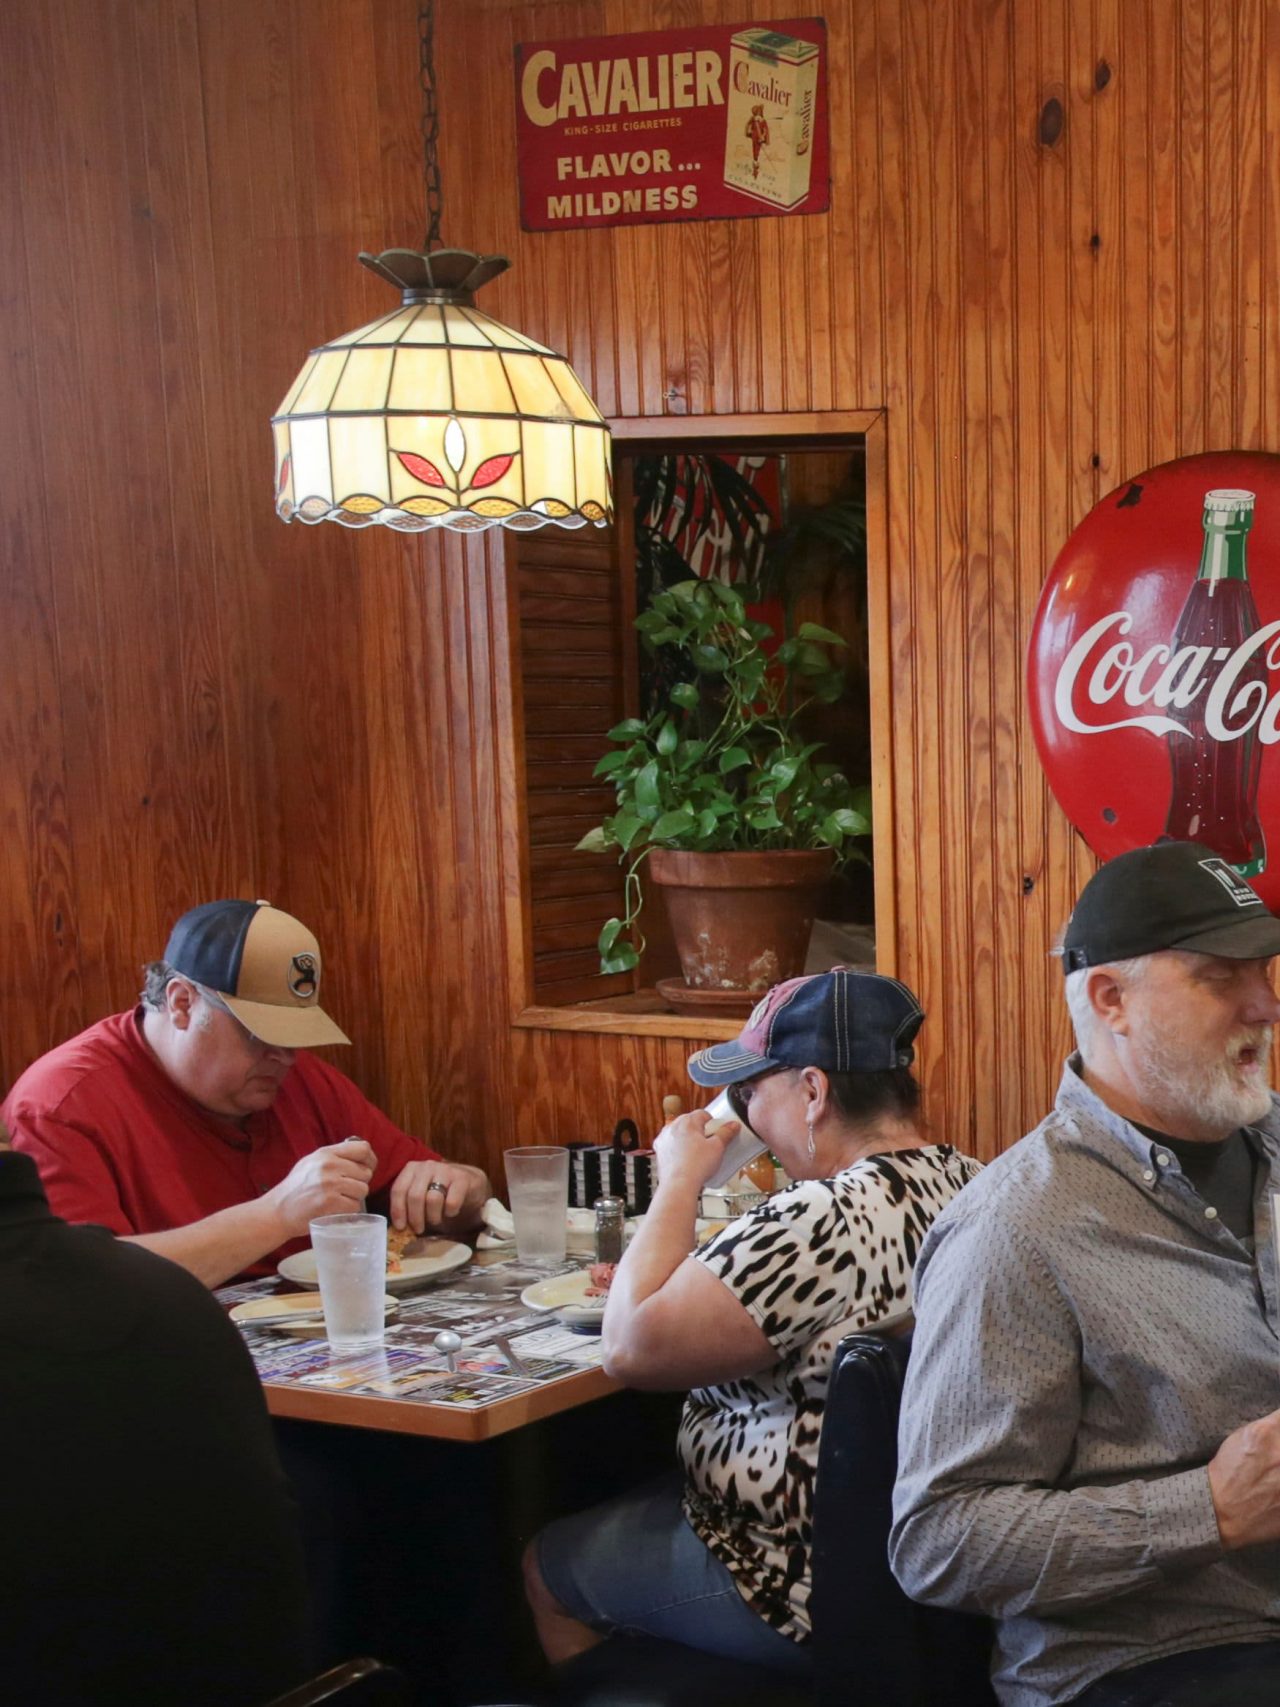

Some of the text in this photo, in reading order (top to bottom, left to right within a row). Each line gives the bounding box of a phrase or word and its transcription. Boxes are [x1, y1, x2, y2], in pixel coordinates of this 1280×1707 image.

[521, 50, 725, 127] CAVALIER
[733, 60, 792, 107] Cavalier
[564, 117, 683, 136] KING-SIZE CIGARETTES
[547, 185, 698, 219] MILDNESS
